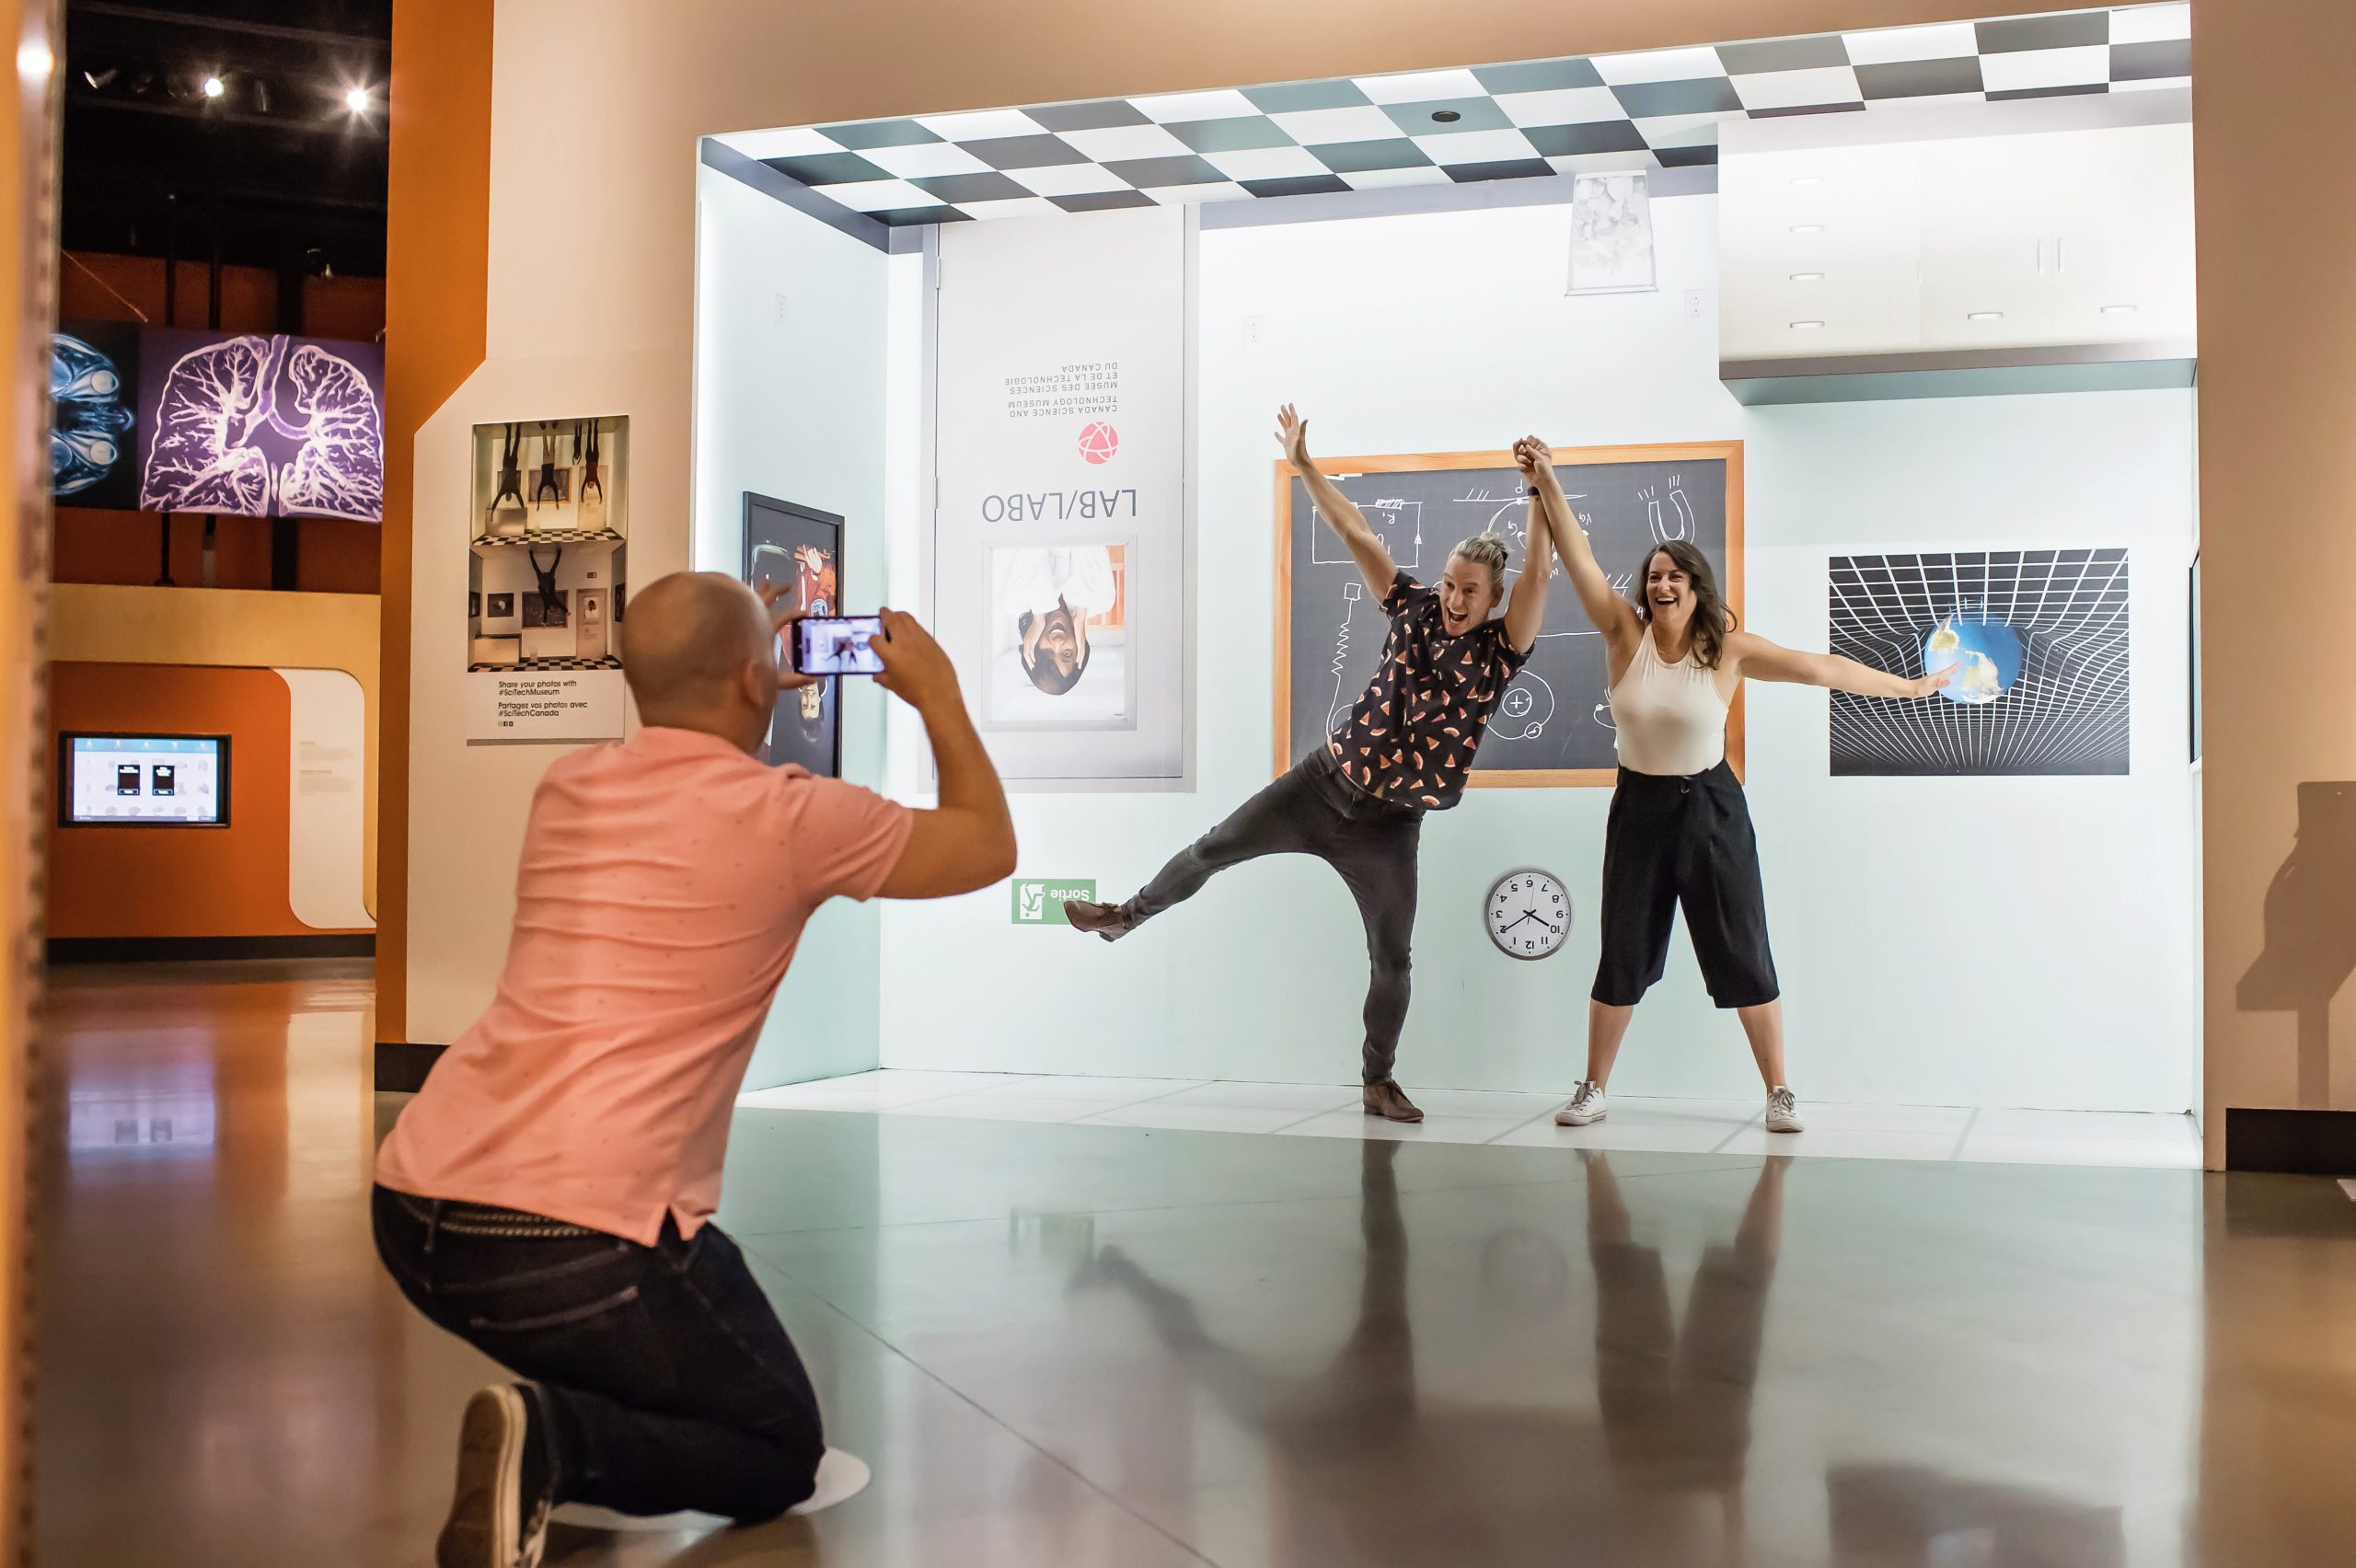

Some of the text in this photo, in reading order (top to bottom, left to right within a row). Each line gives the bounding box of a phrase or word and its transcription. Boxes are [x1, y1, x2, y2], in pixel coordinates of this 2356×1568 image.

[1062, 363, 1100, 372] CANADA
[1005, 375, 1070, 385] TECHNOLOGIE
[1009, 385, 1057, 394] SCIENCES
[1008, 396, 1117, 408] TECHNOLOGY MUSEUM
[1033, 407, 1074, 416] SCIENCE
[1078, 405, 1117, 413] CANADA
[982, 489, 1136, 522] LAB/LABO
[1050, 889, 1090, 901] Sortie
[1550, 925, 1559, 933] 10
